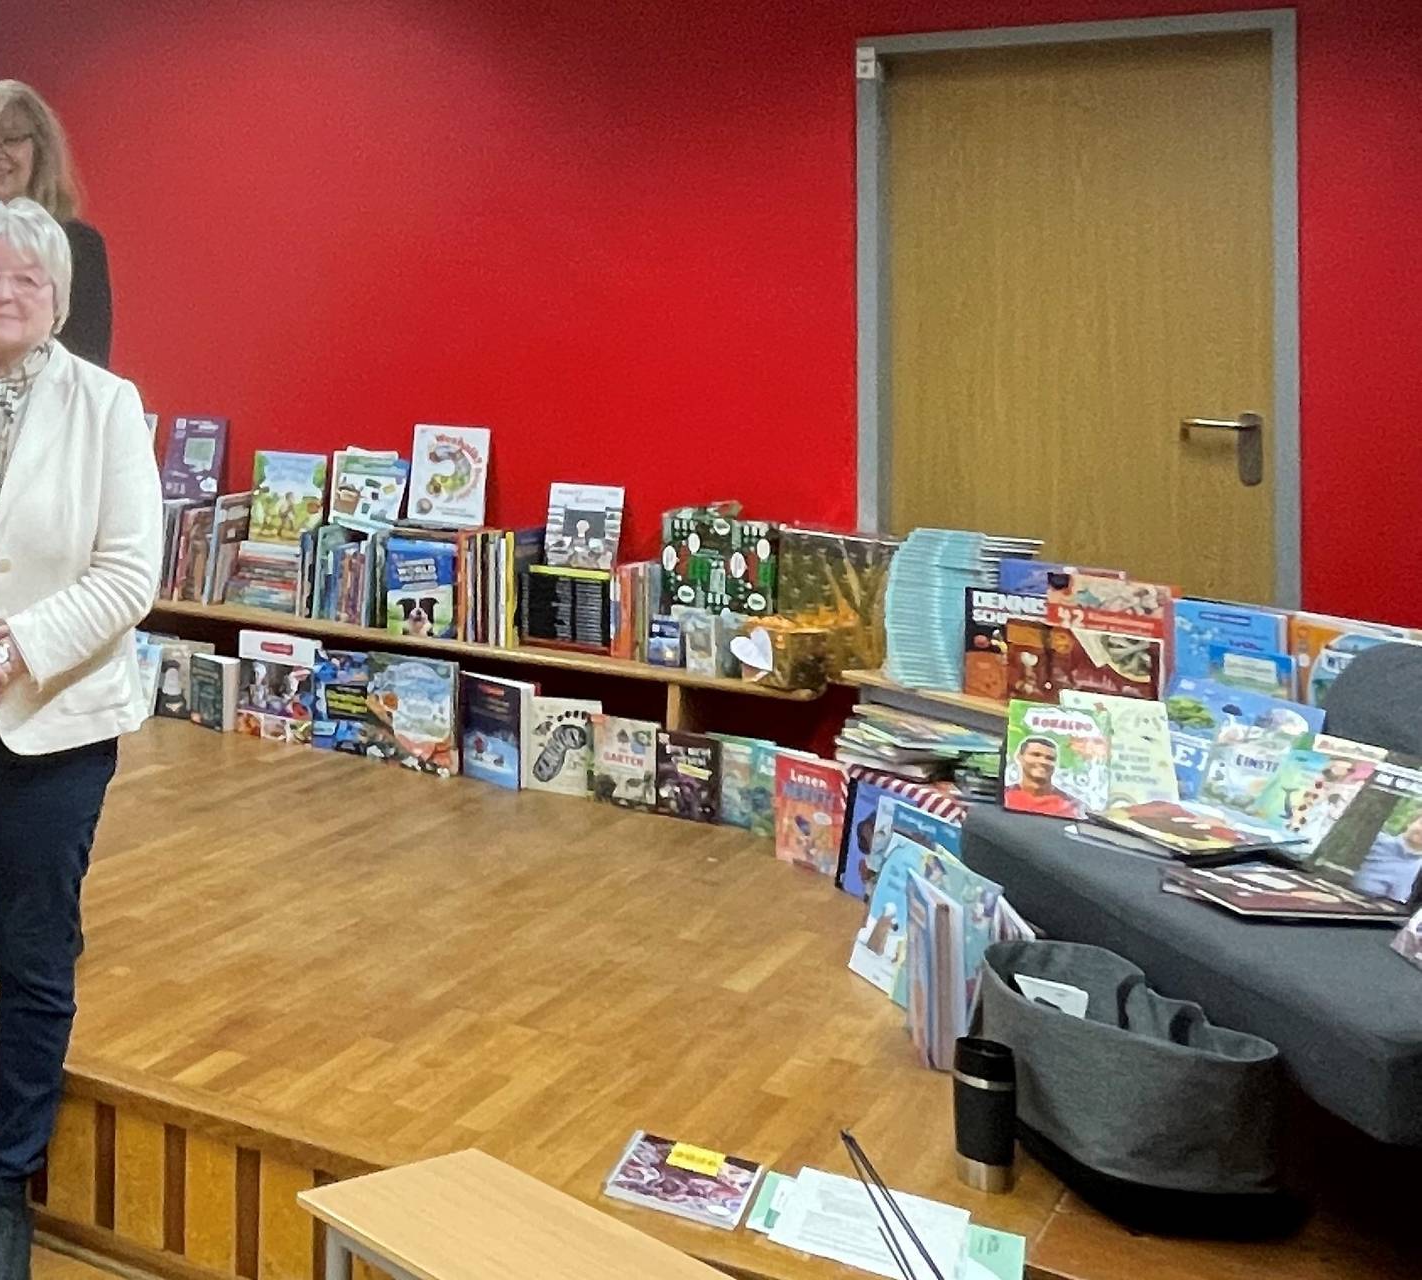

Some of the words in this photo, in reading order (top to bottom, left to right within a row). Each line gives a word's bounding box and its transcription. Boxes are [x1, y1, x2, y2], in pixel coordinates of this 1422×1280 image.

[973, 590, 1048, 615] DENNIS
[1032, 716, 1093, 731] RONALDO
[602, 751, 644, 767] GARTEN
[790, 767, 827, 790] Lesen
